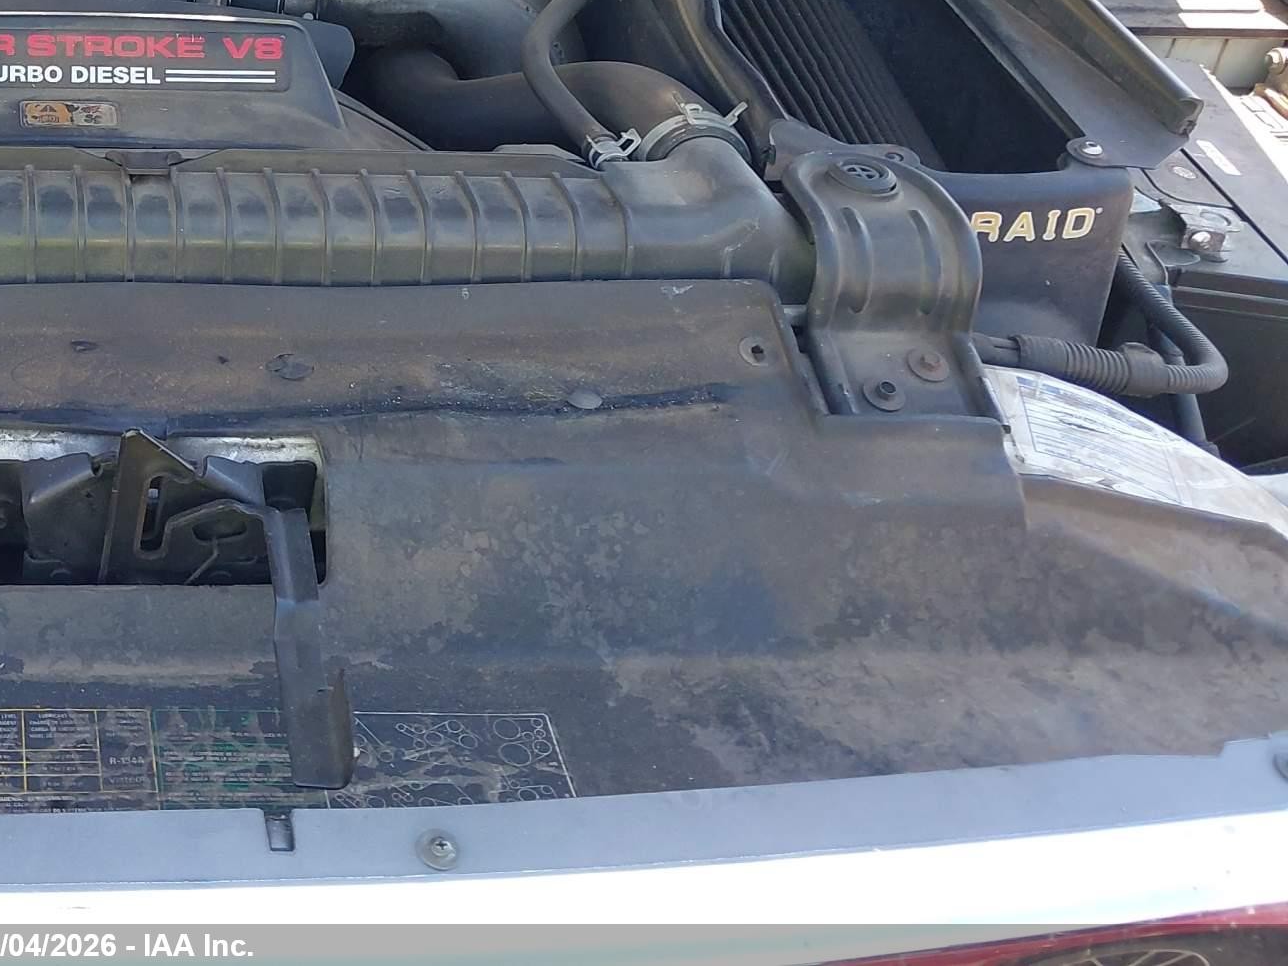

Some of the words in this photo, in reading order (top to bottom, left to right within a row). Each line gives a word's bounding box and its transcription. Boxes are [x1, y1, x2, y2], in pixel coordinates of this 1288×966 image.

[27, 33, 205, 59] STROKE
[223, 35, 284, 60] V8
[70, 65, 161, 85] DIESEL
